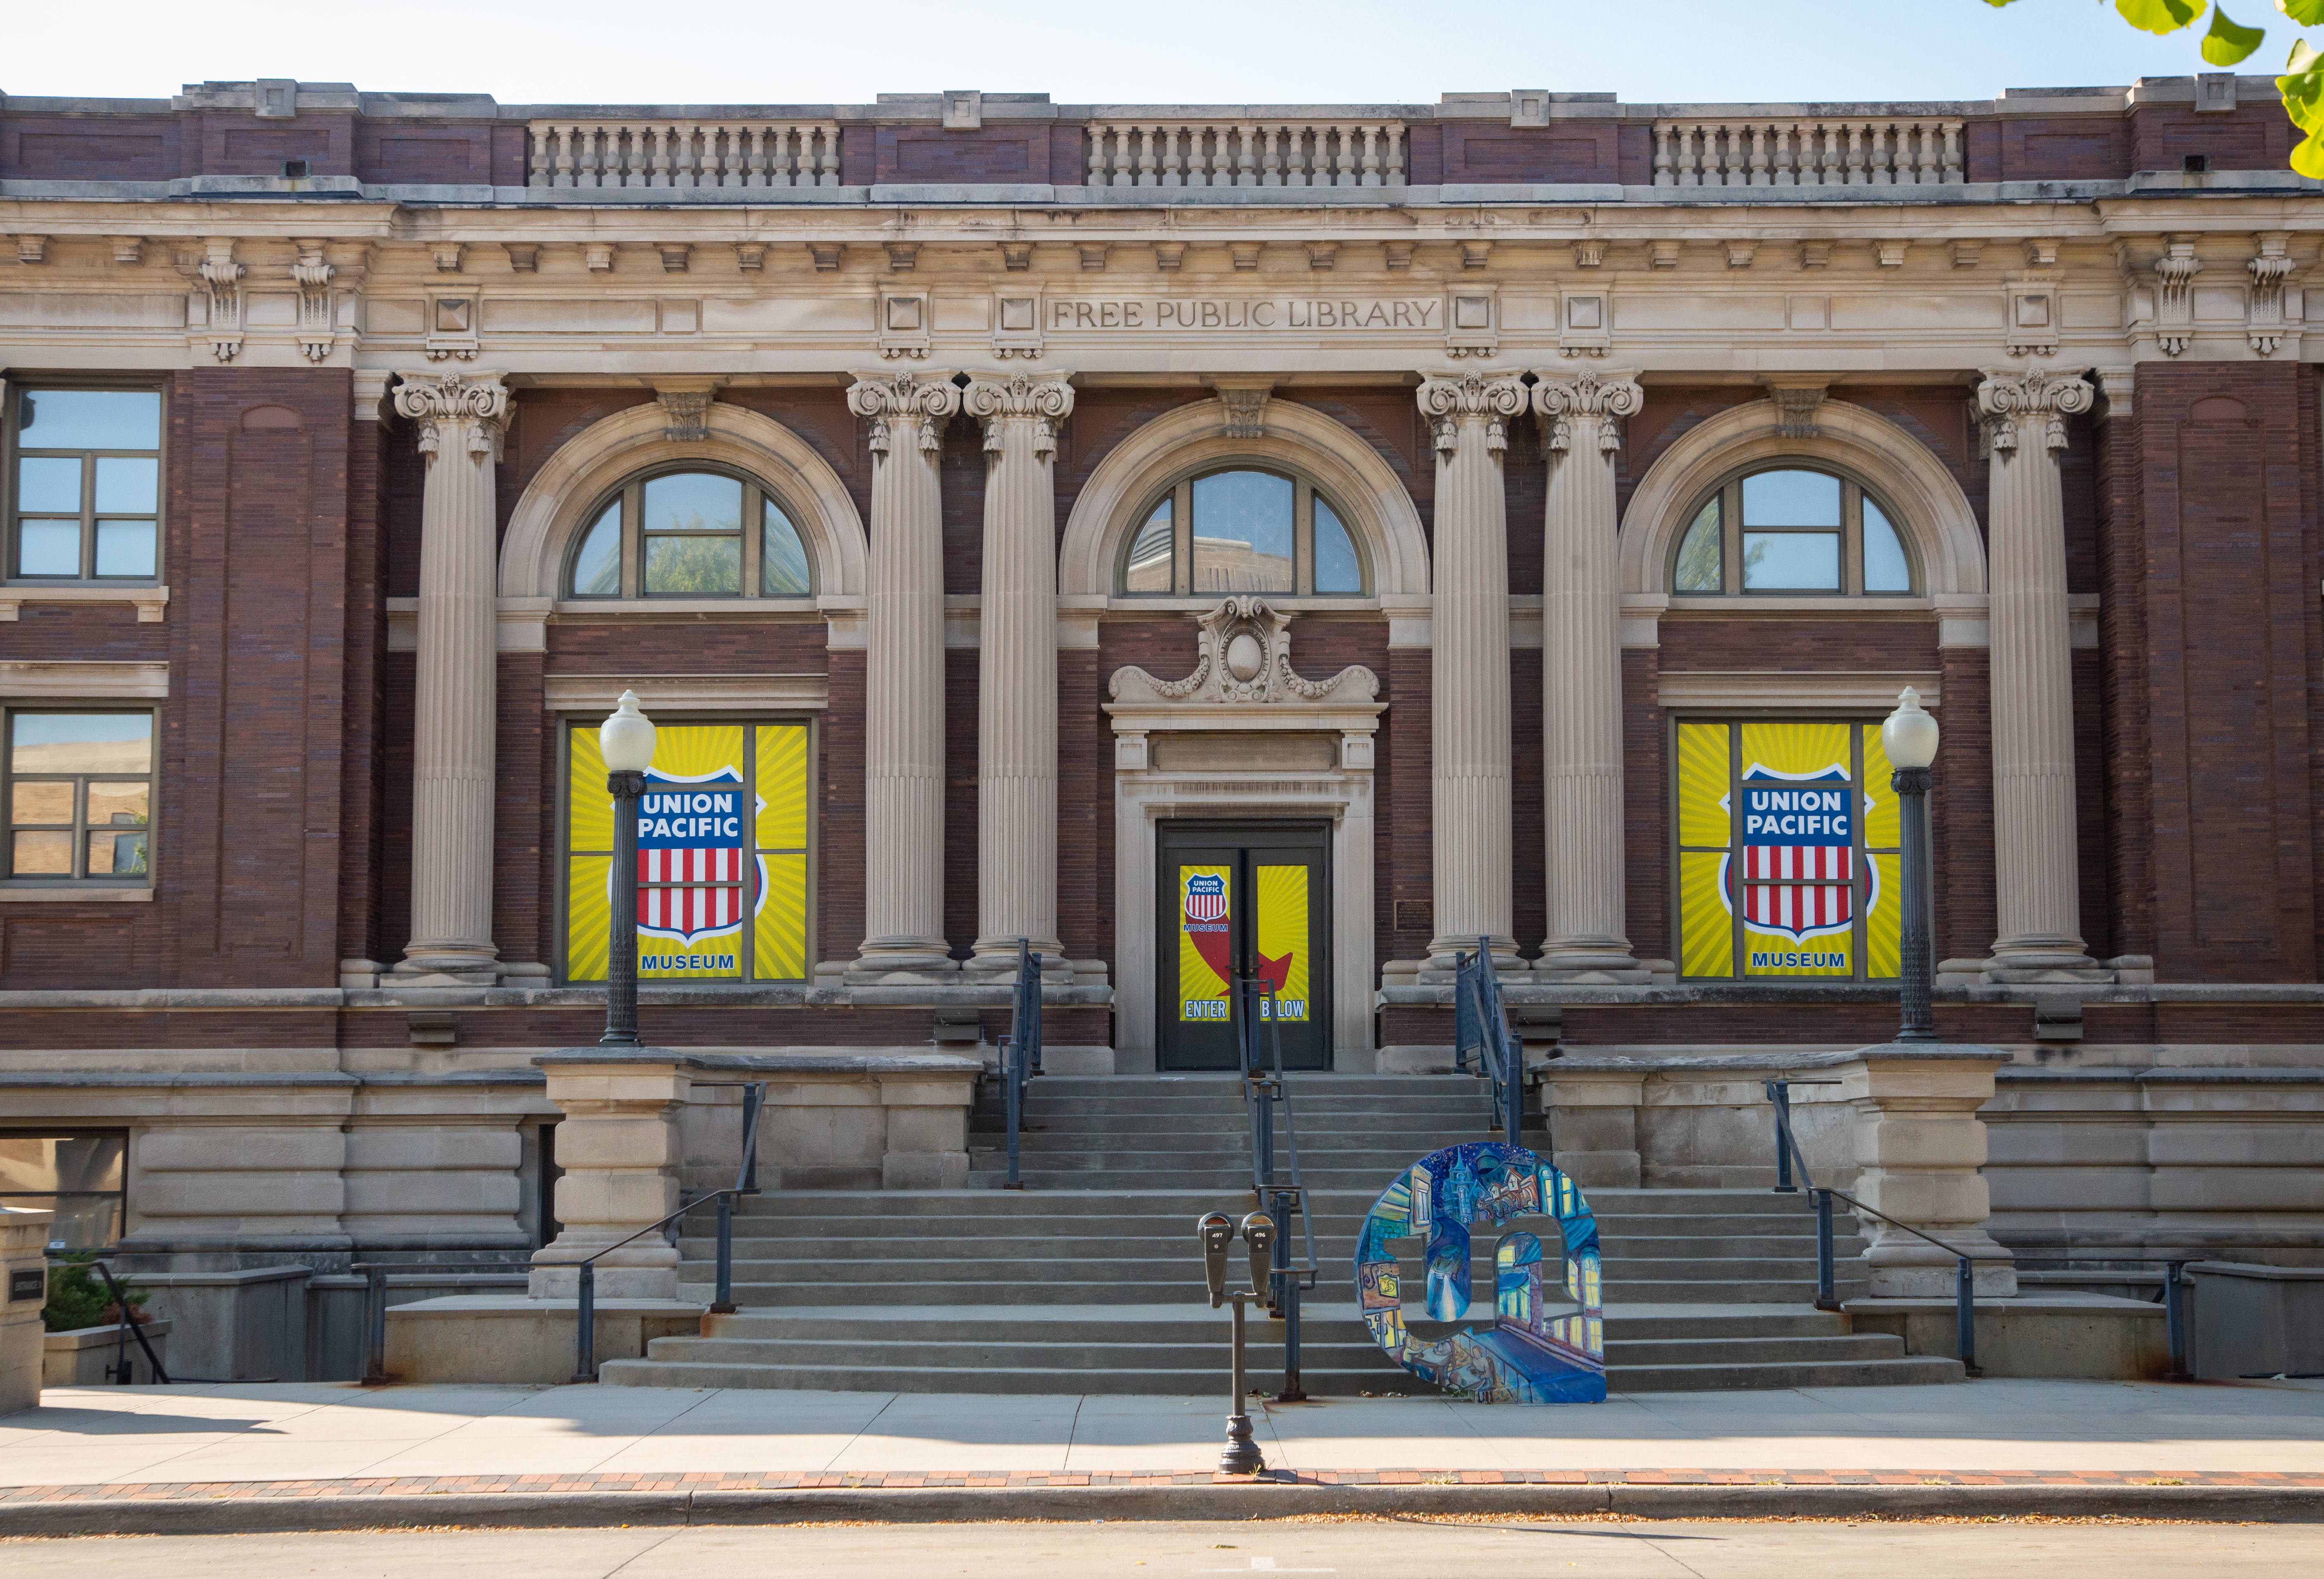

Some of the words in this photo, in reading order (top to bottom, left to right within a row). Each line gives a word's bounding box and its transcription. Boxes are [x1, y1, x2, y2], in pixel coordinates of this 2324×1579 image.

[1053, 302, 1143, 327] FREE
[1156, 301, 1276, 327] PUBLIC
[1288, 301, 1437, 327] LIBRARY
[644, 794, 732, 813] UNION
[1752, 791, 1841, 811] UNION
[638, 817, 738, 837] PACIFIC
[1747, 815, 1847, 835] PACIFIC
[641, 954, 734, 970] MUSEUM
[1752, 952, 1845, 968] MUSEUM
[1185, 1000, 1226, 1018] ENTER
[1261, 1000, 1305, 1017] BLOW
